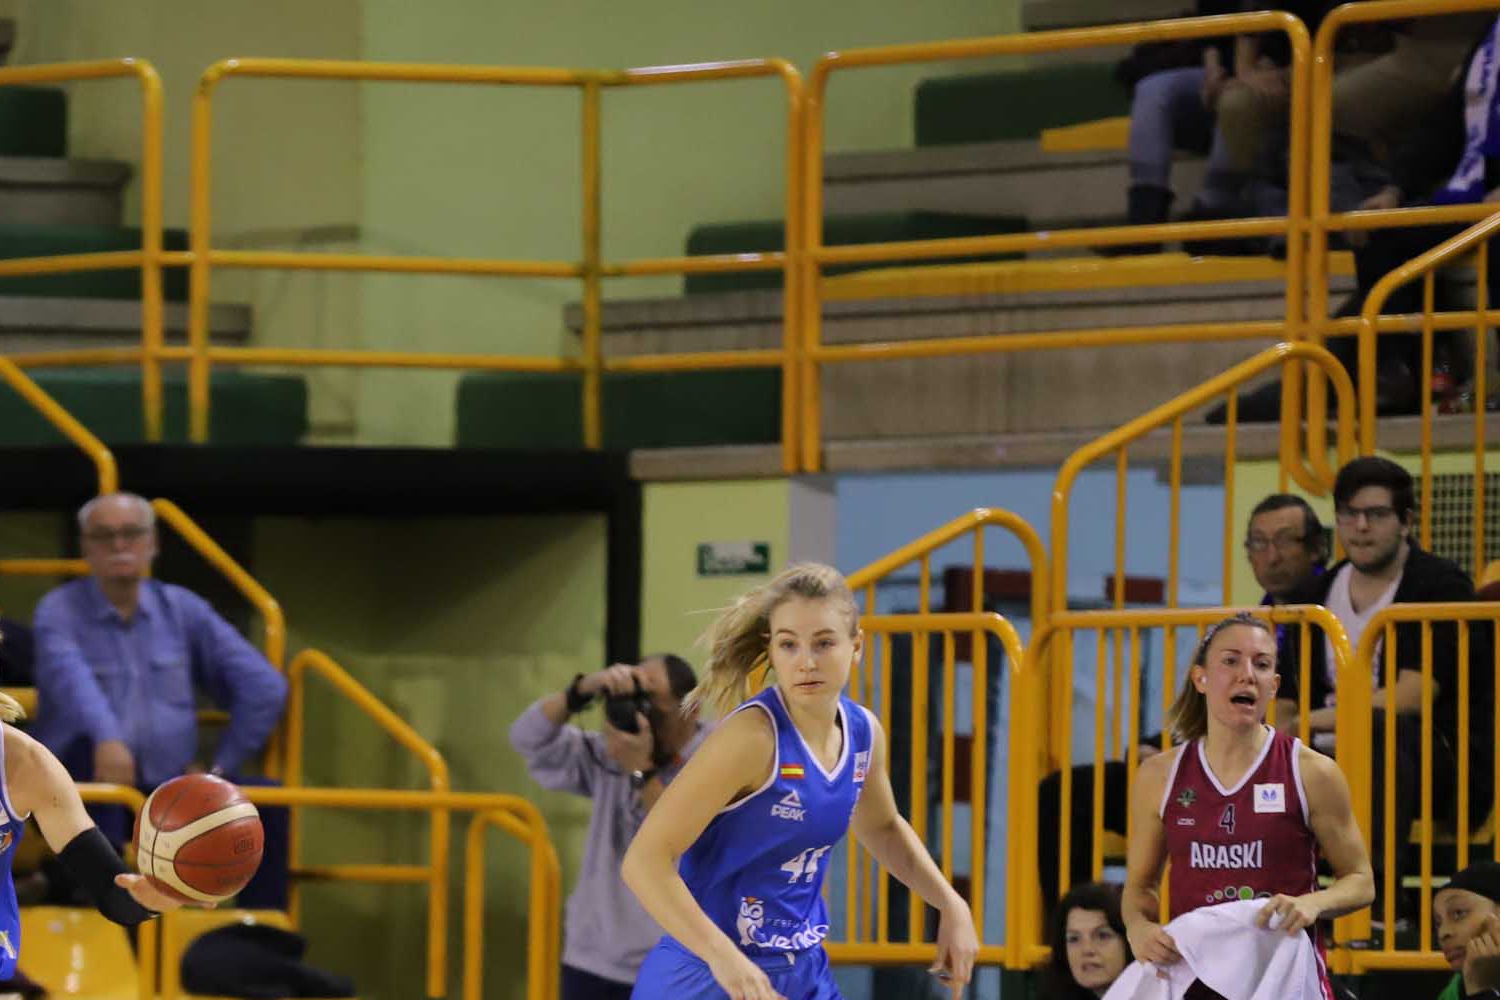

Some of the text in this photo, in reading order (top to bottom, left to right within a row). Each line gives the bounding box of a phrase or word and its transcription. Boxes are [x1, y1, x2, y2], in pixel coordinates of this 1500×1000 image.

[771, 804, 807, 822] PEAK
[1219, 803, 1237, 835] 4
[1189, 839, 1263, 869] ARASKI
